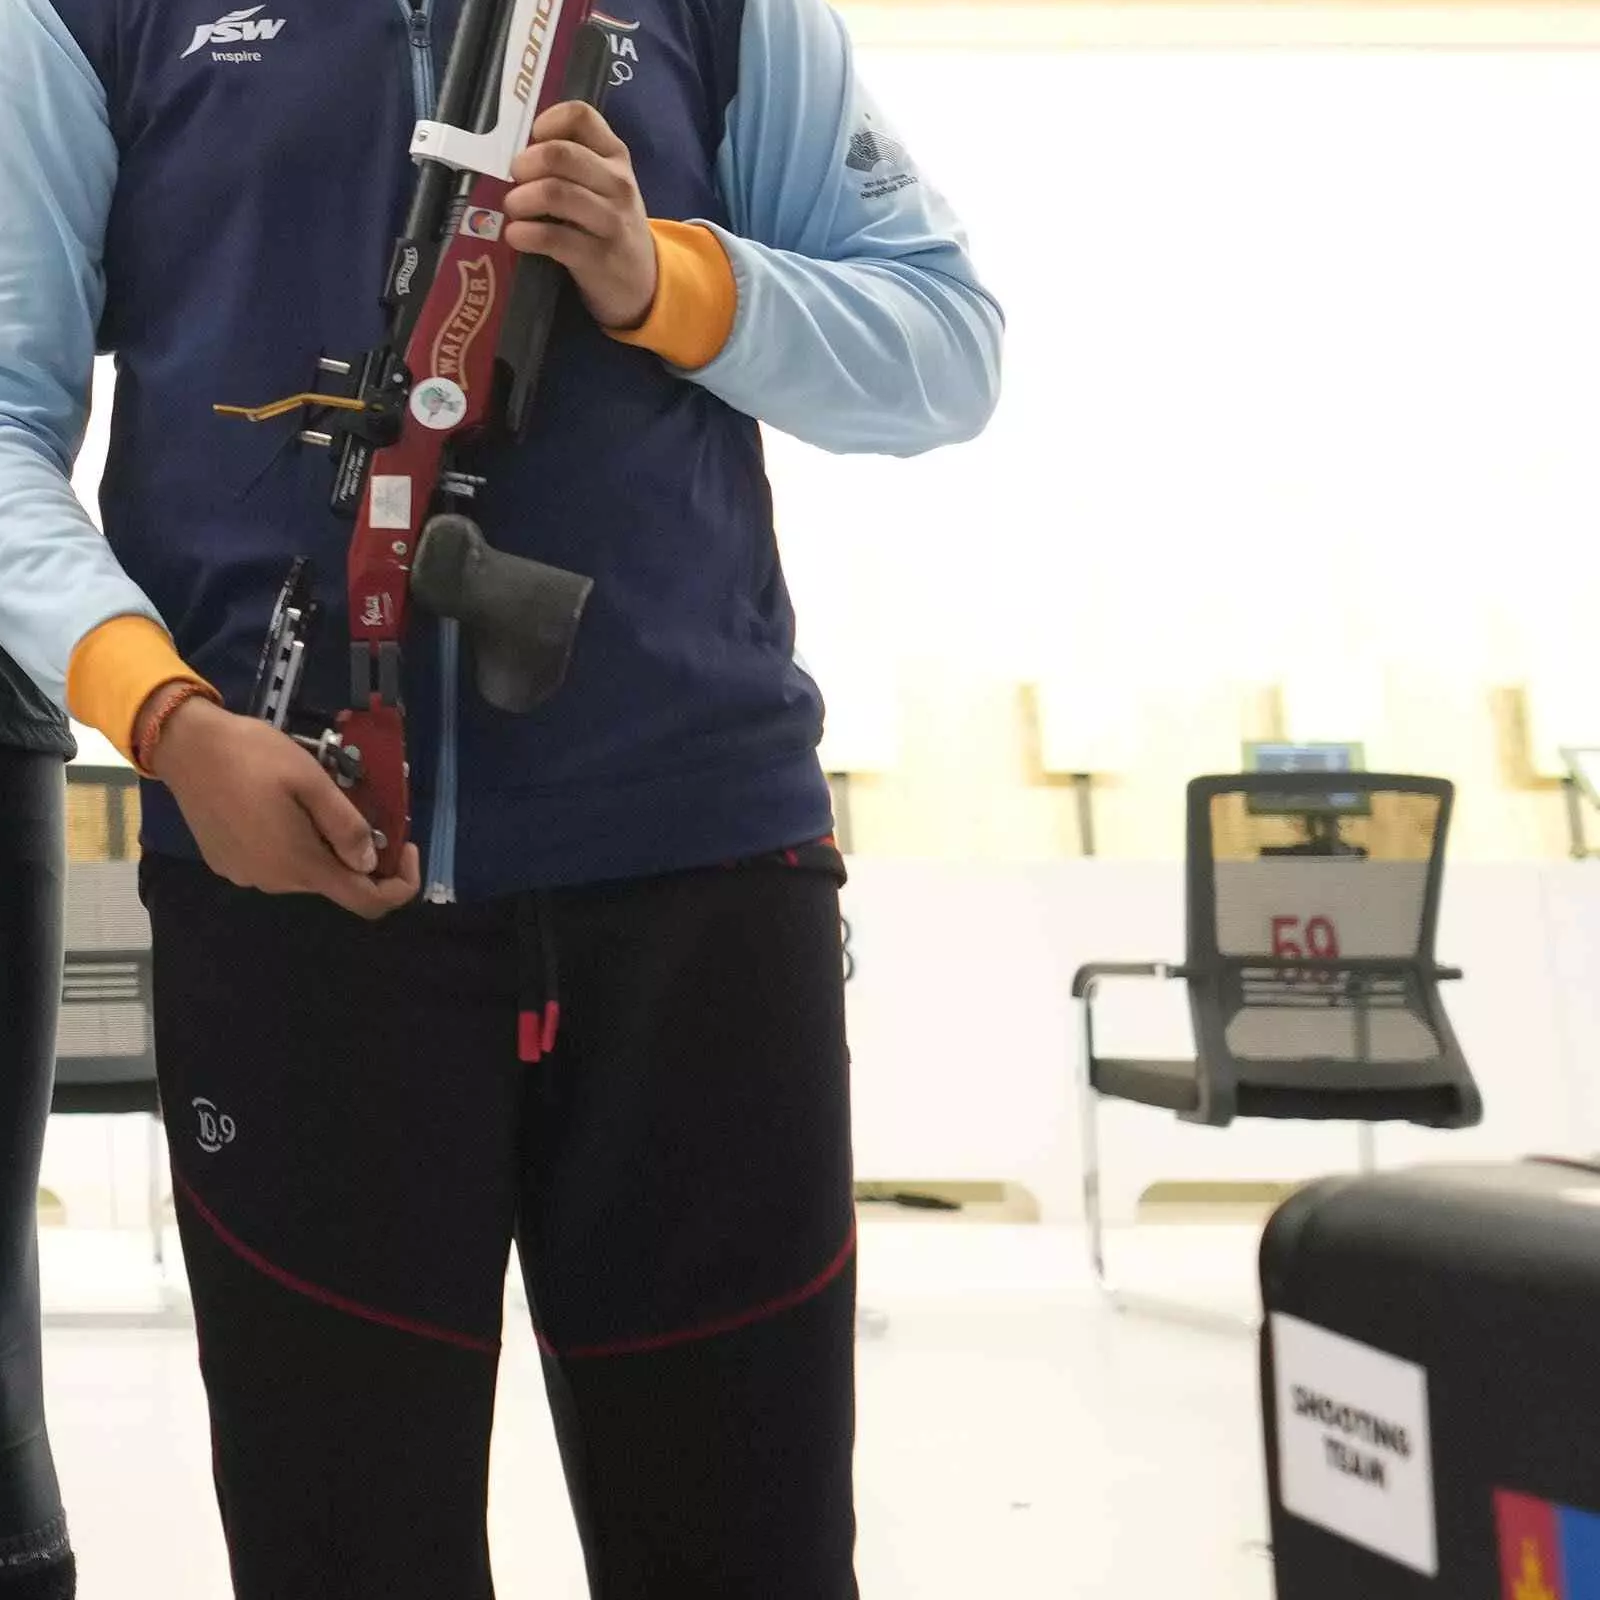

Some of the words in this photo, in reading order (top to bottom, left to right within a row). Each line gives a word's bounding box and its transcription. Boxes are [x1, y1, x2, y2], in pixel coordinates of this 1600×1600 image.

[181, 5, 288, 59] JSW
[212, 50, 262, 64] Inspire
[437, 277, 490, 376] WALTHER
[1291, 1381, 1411, 1460] SHOOTING
[1322, 1434, 1388, 1491] TEAM
